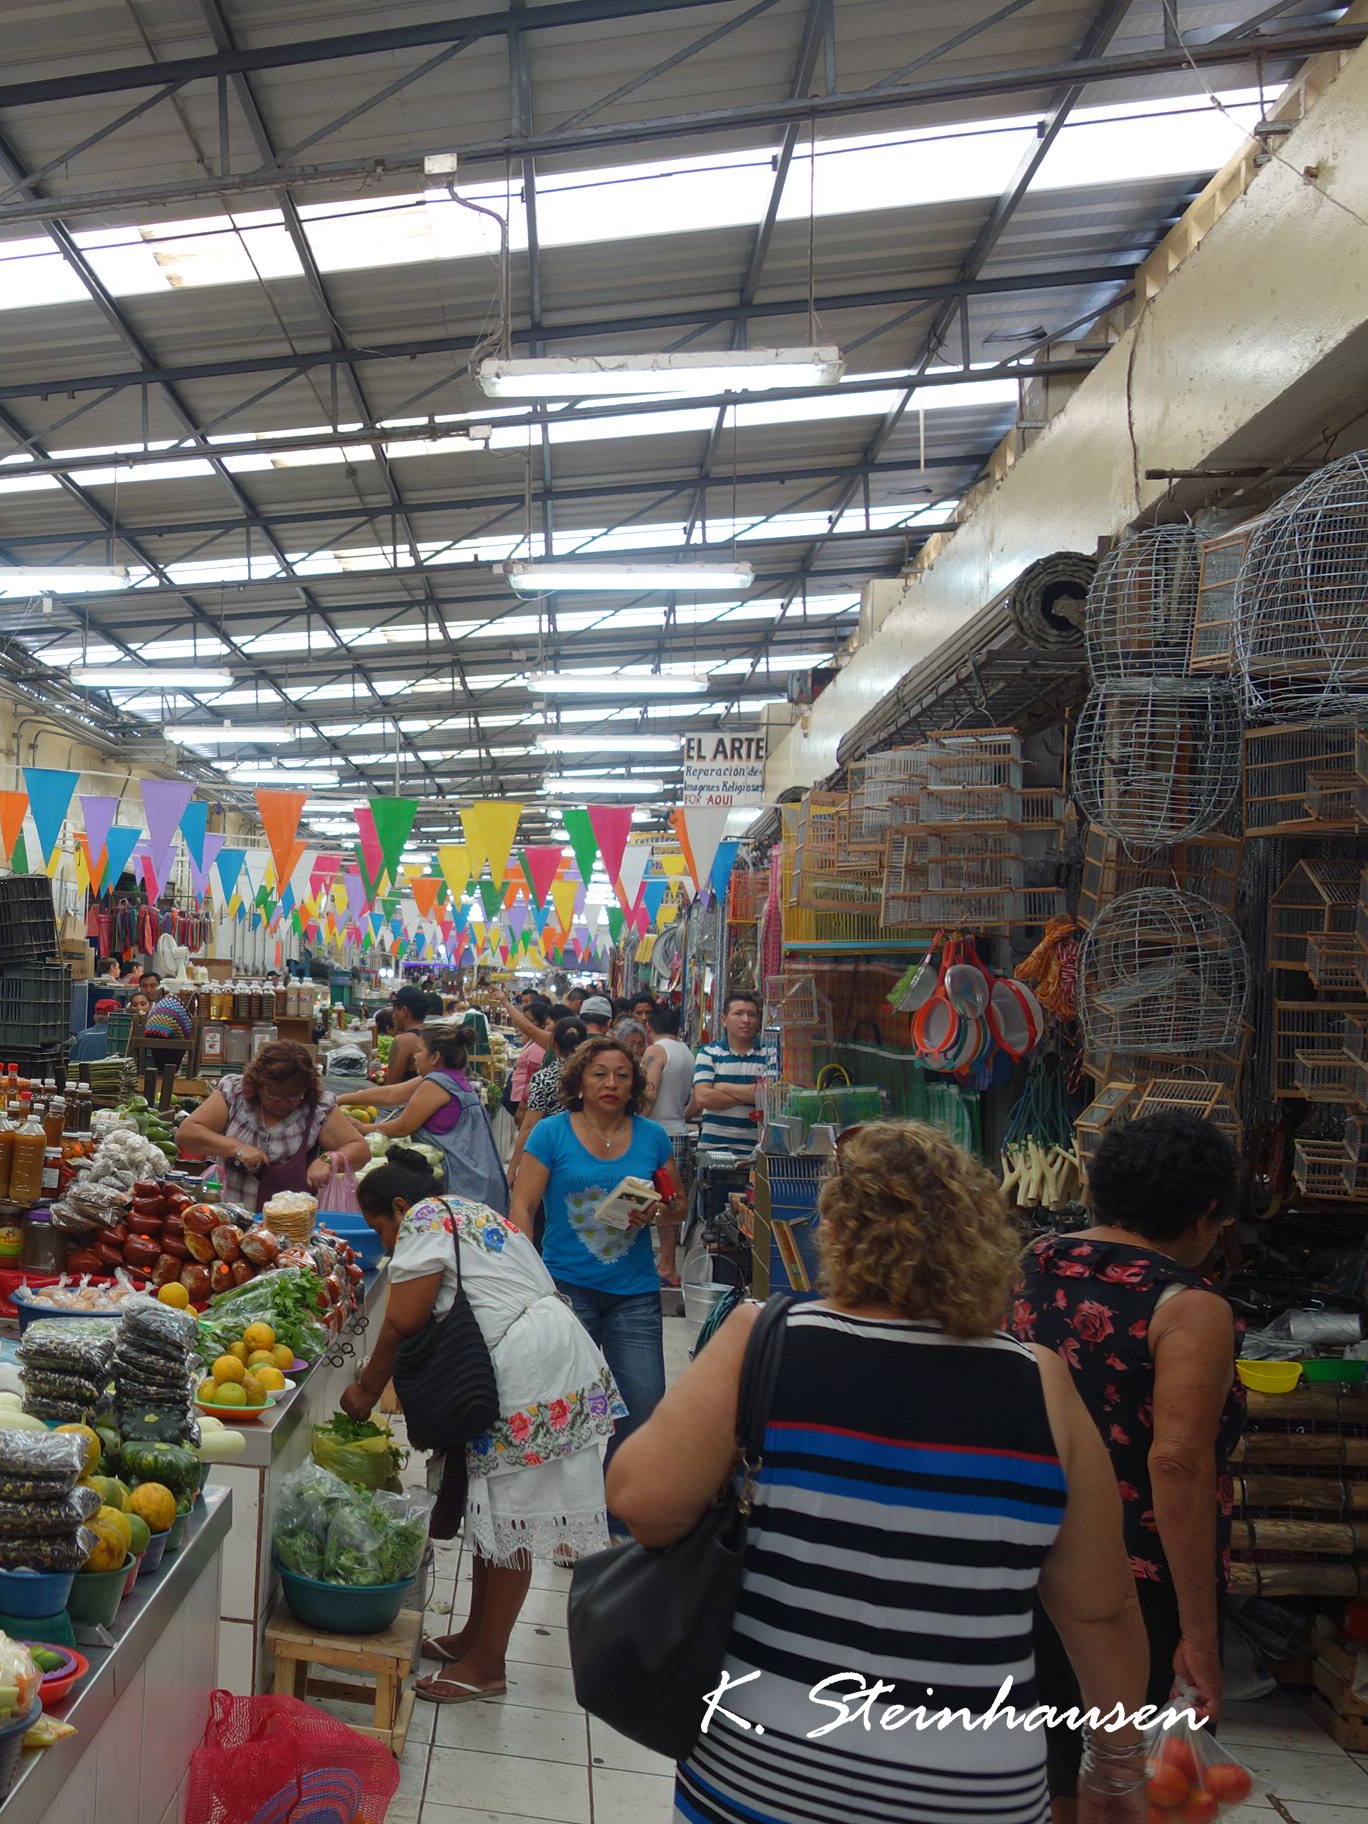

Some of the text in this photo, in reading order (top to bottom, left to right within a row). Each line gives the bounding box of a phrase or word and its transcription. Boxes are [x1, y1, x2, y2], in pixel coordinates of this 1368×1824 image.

[686, 737, 765, 761] EL ARTE
[686, 765, 758, 779] Reparación de
[722, 781, 765, 795] Religiosas
[684, 794, 701, 805] POR
